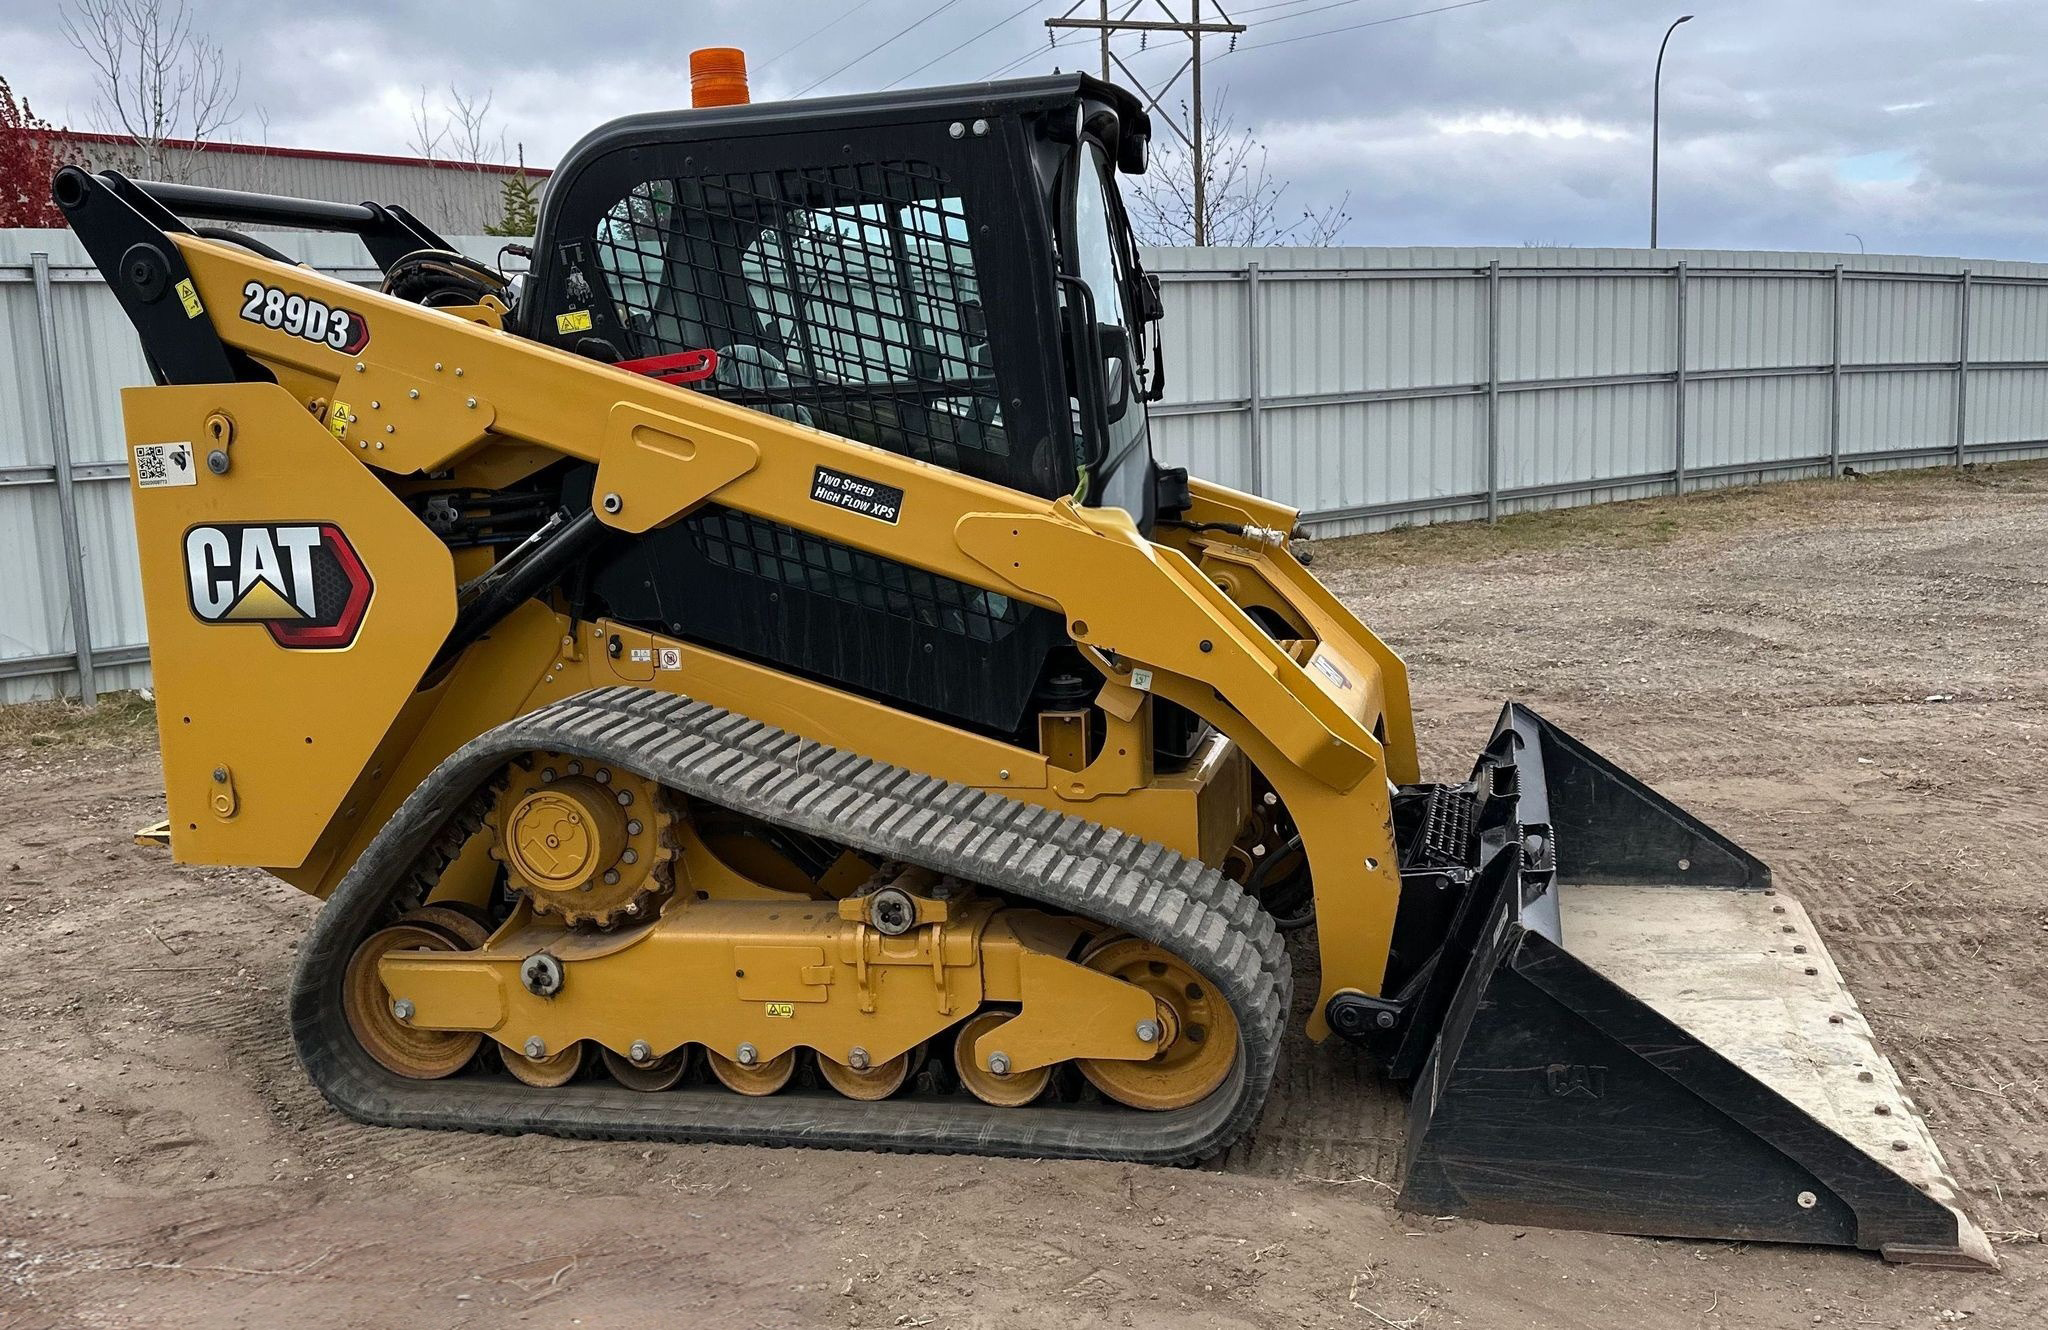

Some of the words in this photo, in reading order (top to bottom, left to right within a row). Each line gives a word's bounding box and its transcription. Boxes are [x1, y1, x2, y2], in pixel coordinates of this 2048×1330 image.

[242, 282, 350, 348] 289D3
[817, 471, 841, 487] TWO
[841, 478, 875, 497] SPEED
[814, 486, 841, 503] HIGH
[841, 494, 871, 511] FLOW
[870, 502, 896, 519] XPS
[187, 526, 321, 619] CAT
[1546, 1064, 1608, 1098] CAT
